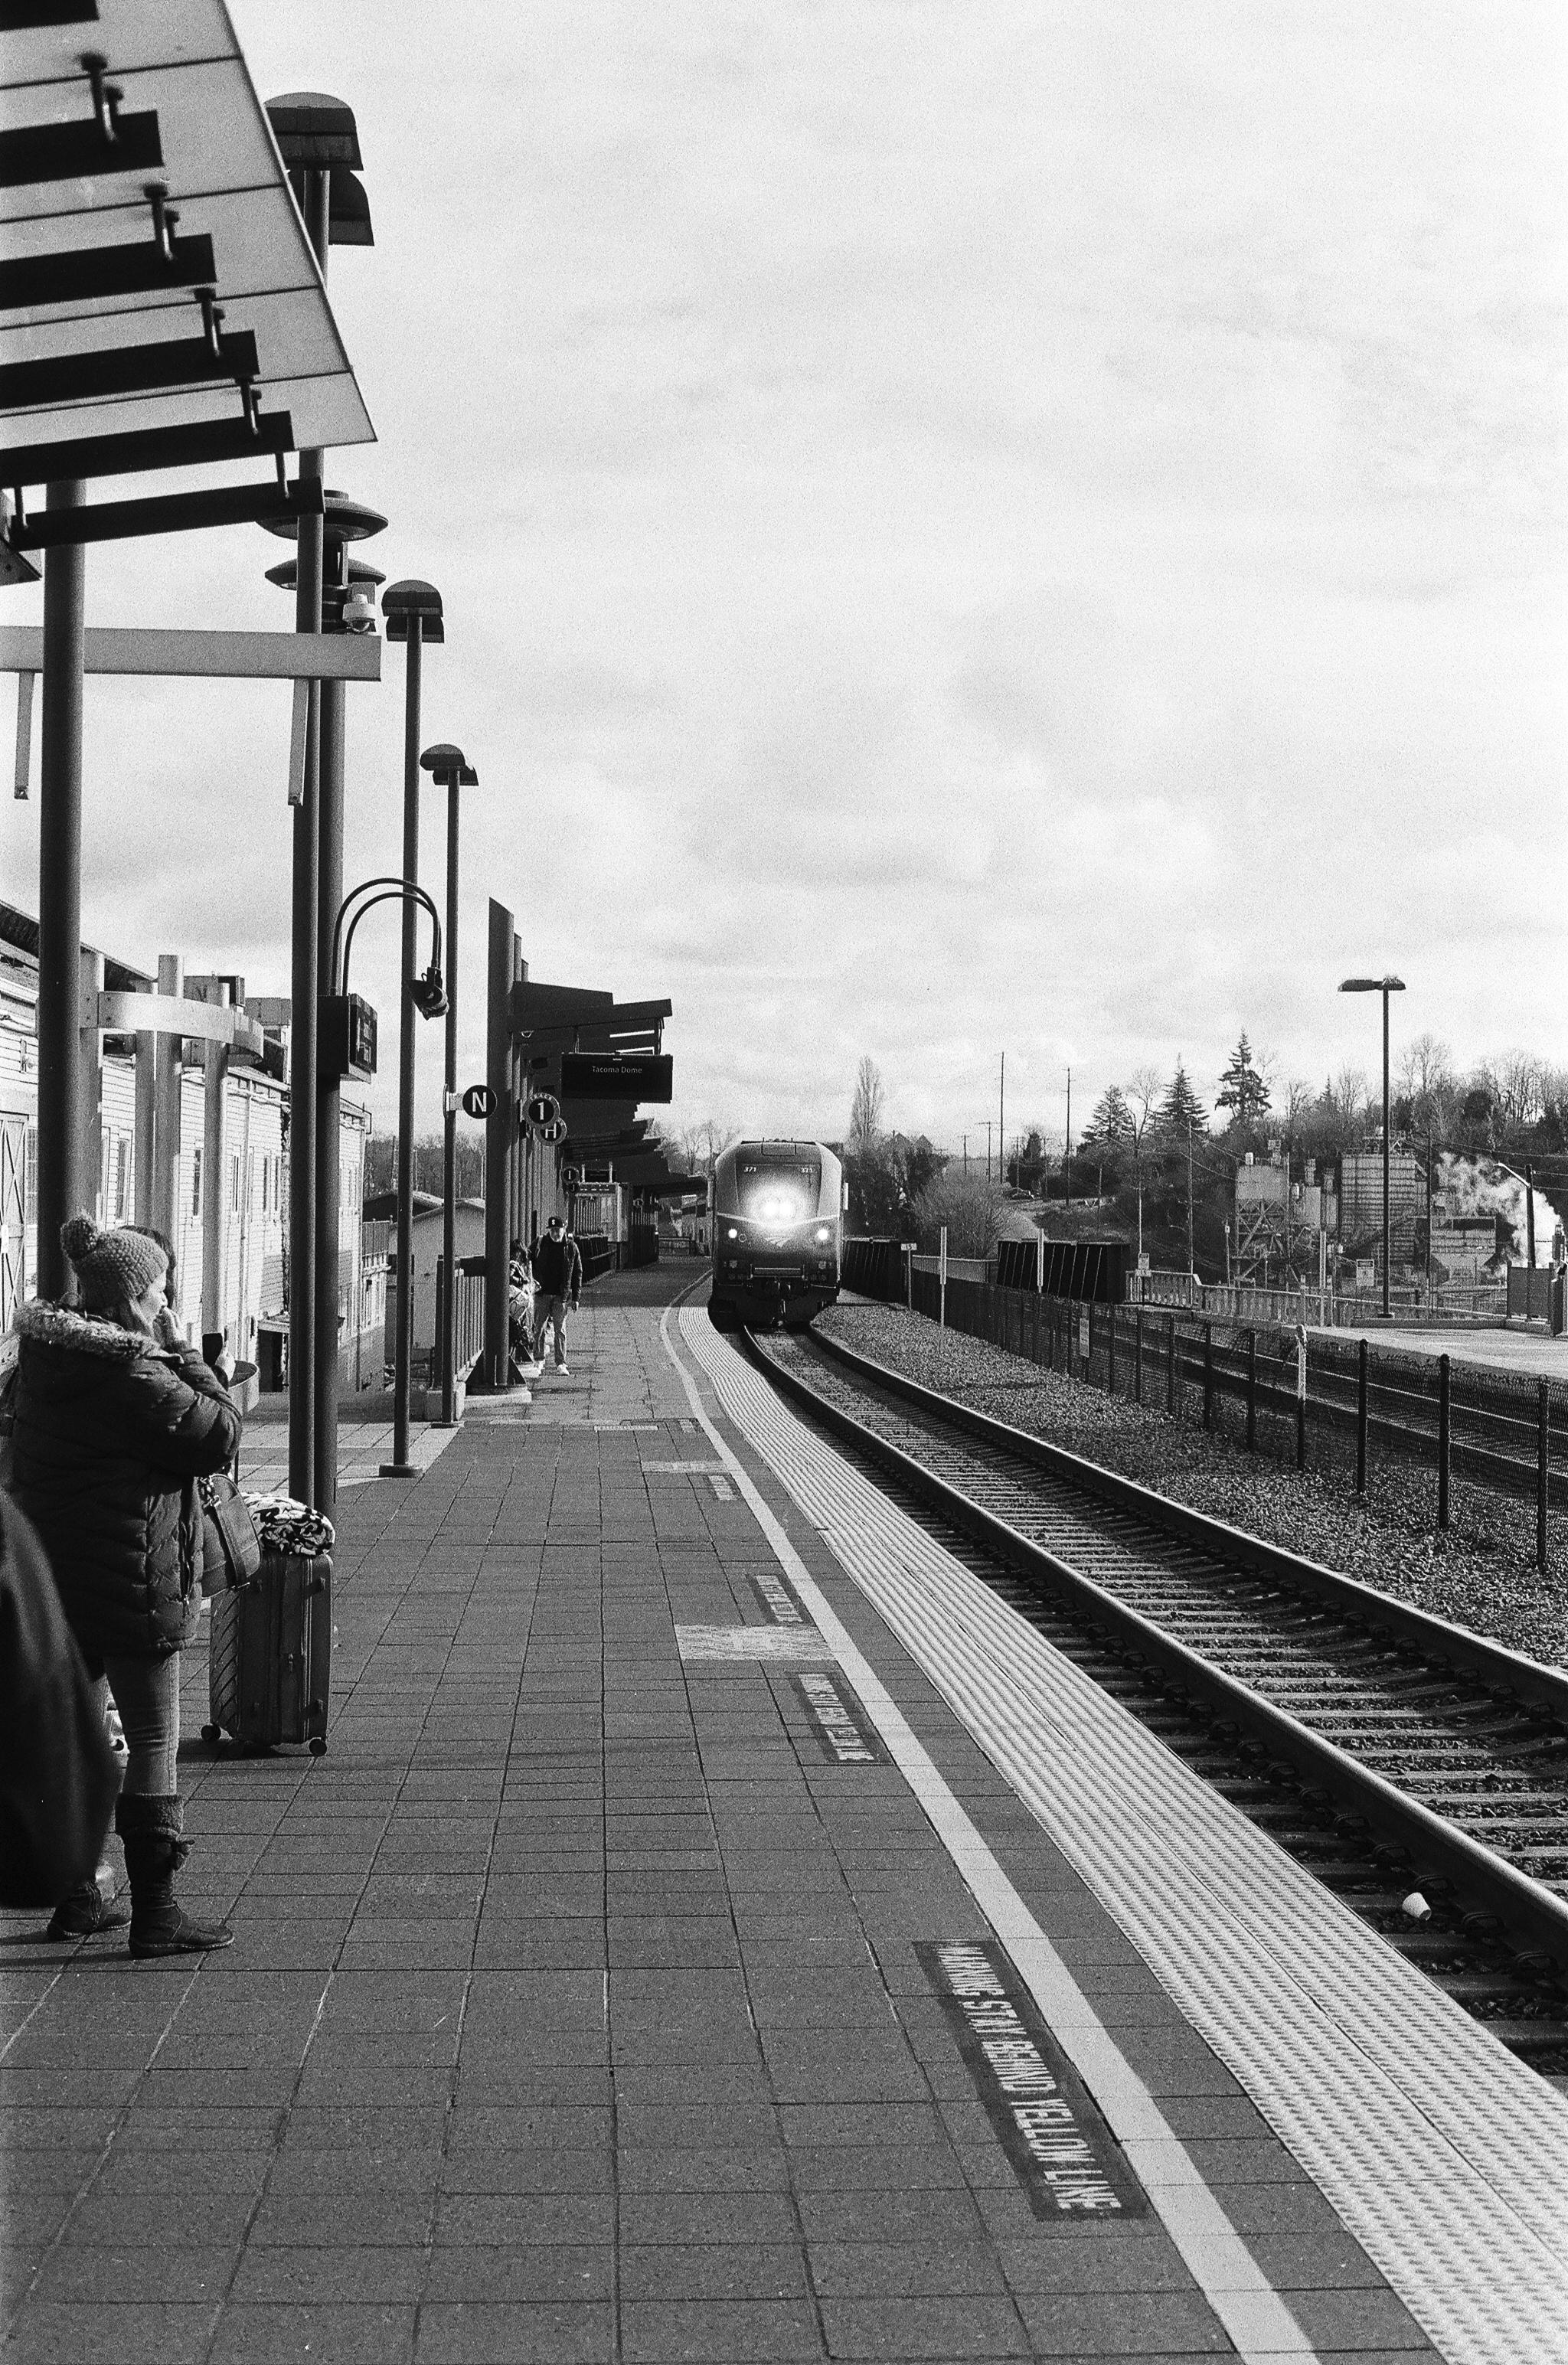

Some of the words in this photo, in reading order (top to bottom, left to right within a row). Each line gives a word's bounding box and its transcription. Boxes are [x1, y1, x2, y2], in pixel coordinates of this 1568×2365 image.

[472, 1092, 487, 1112] N
[537, 1102, 544, 1120] 1
[545, 1122, 557, 1138] H
[936, 1946, 1005, 1996] WARNING
[961, 2001, 1027, 2034] STAY
[982, 2041, 1057, 2091] BEHIND
[1011, 2099, 1096, 2161] YELLOW
[1044, 2170, 1122, 2209] LINE
